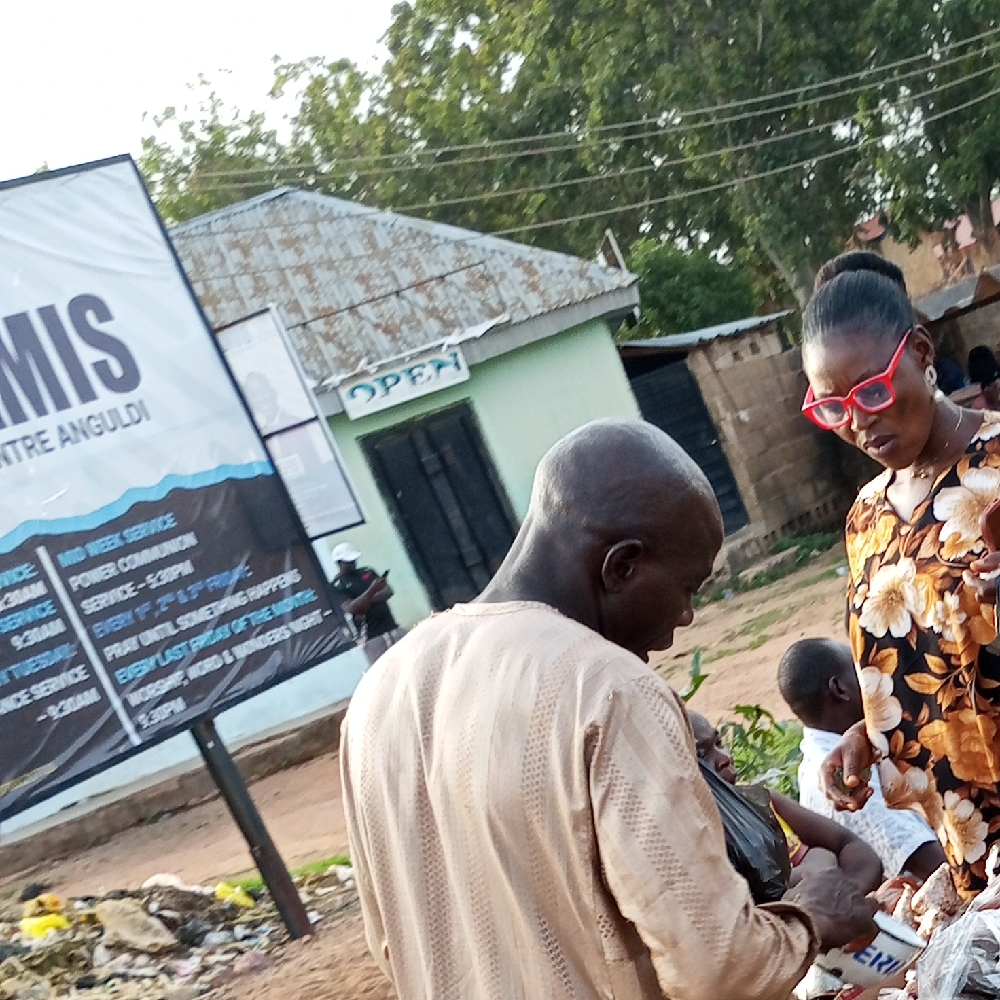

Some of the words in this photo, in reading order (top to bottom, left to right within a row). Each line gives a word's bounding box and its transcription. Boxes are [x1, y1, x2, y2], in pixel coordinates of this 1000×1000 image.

[347, 351, 461, 403] OPEN
[57, 399, 151, 449] ANGULDI
[57, 546, 87, 568] MID
[85, 531, 125, 557] WEEK
[122, 512, 178, 543] SERVICE
[68, 562, 121, 592] POWER
[117, 531, 199, 574] COMMUNION
[80, 581, 139, 616] SERVICE
[145, 559, 195, 589] 5:30PM
[103, 635, 140, 662] PRAY
[139, 621, 180, 647] UNTIL
[176, 590, 249, 631] SOMETHING
[246, 568, 302, 602] HAPPENS
[92, 610, 135, 639] EVERY
[186, 653, 224, 681] WORD
[231, 624, 292, 660] WONDERS
[286, 608, 324, 634] NIGHT
[114, 655, 157, 685] EVERY
[156, 641, 190, 667] LAST
[189, 623, 232, 652] FRIDAY
[29, 664, 91, 701] SERVICE
